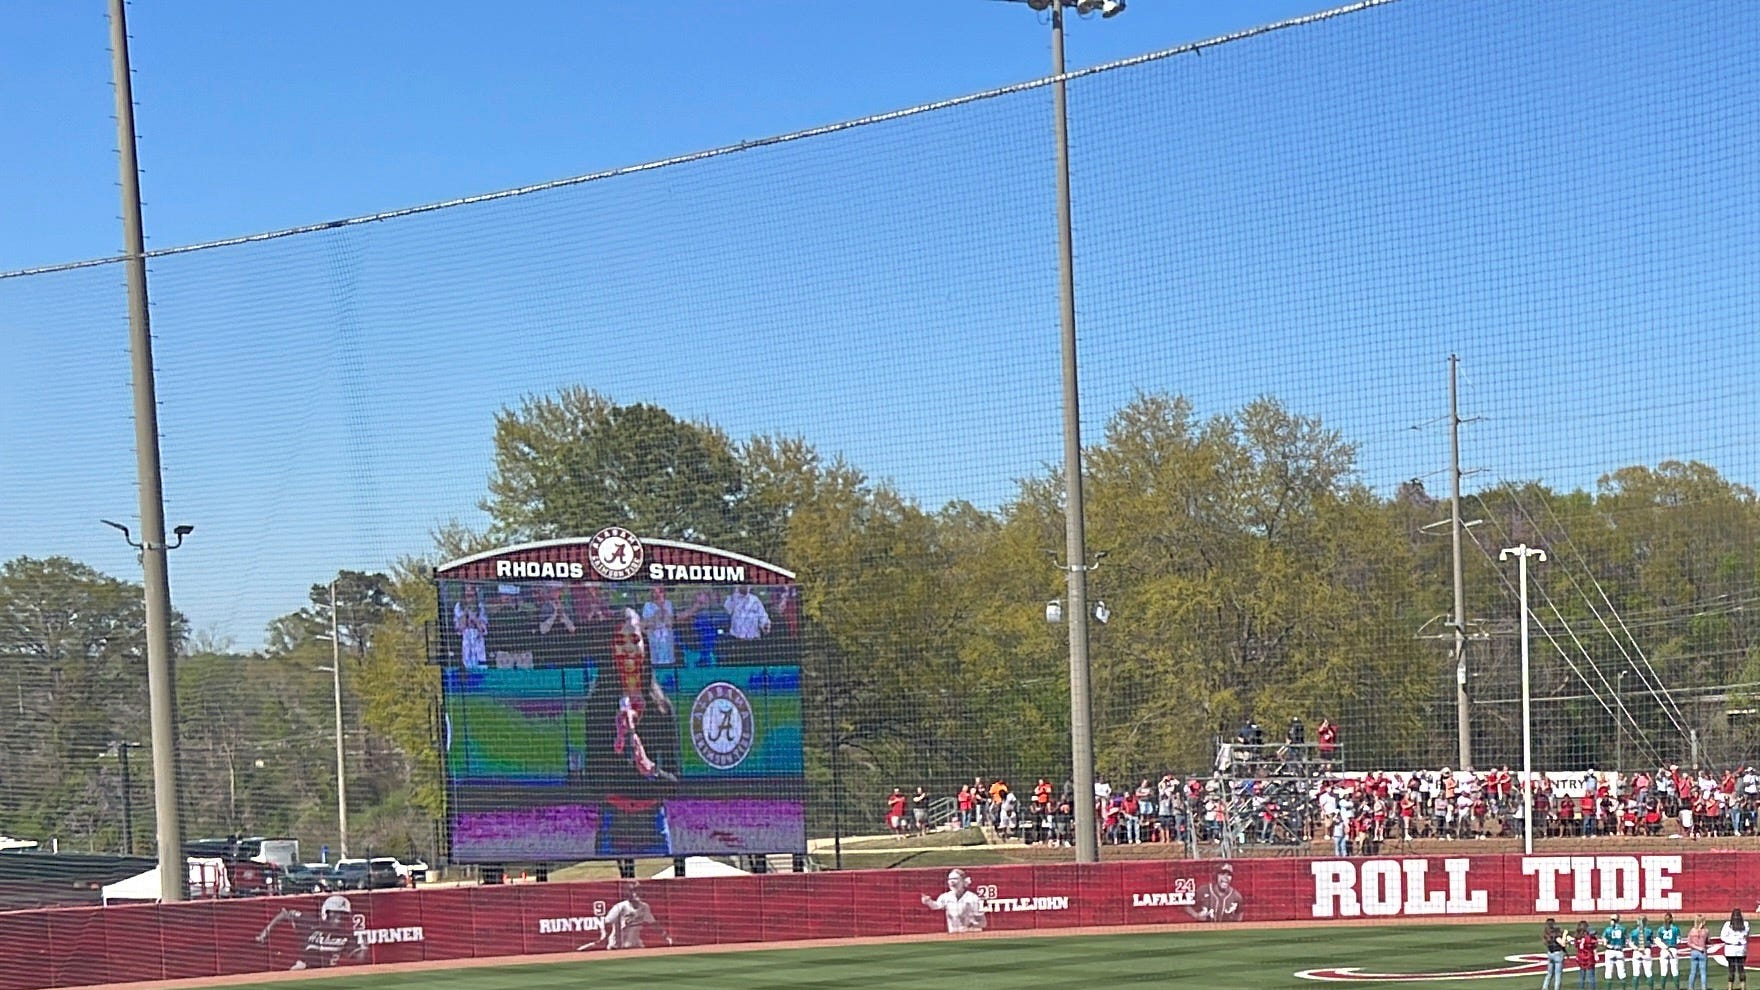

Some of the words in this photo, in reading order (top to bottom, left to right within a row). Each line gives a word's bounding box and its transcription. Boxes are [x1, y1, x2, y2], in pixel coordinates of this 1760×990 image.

[496, 561, 583, 578] RHOADS
[650, 563, 745, 581] STADIUM
[977, 885, 997, 899] 28
[1174, 878, 1196, 892] 24
[1311, 859, 1488, 917] ROLL
[1522, 855, 1683, 912] TIDE
[977, 896, 1069, 913] LITTLEJOHN
[1132, 892, 1196, 906] LAFAELE
[593, 900, 606, 916] 9
[352, 914, 366, 930] 2
[539, 916, 606, 934] RUNYON
[353, 926, 424, 945] TURNER
